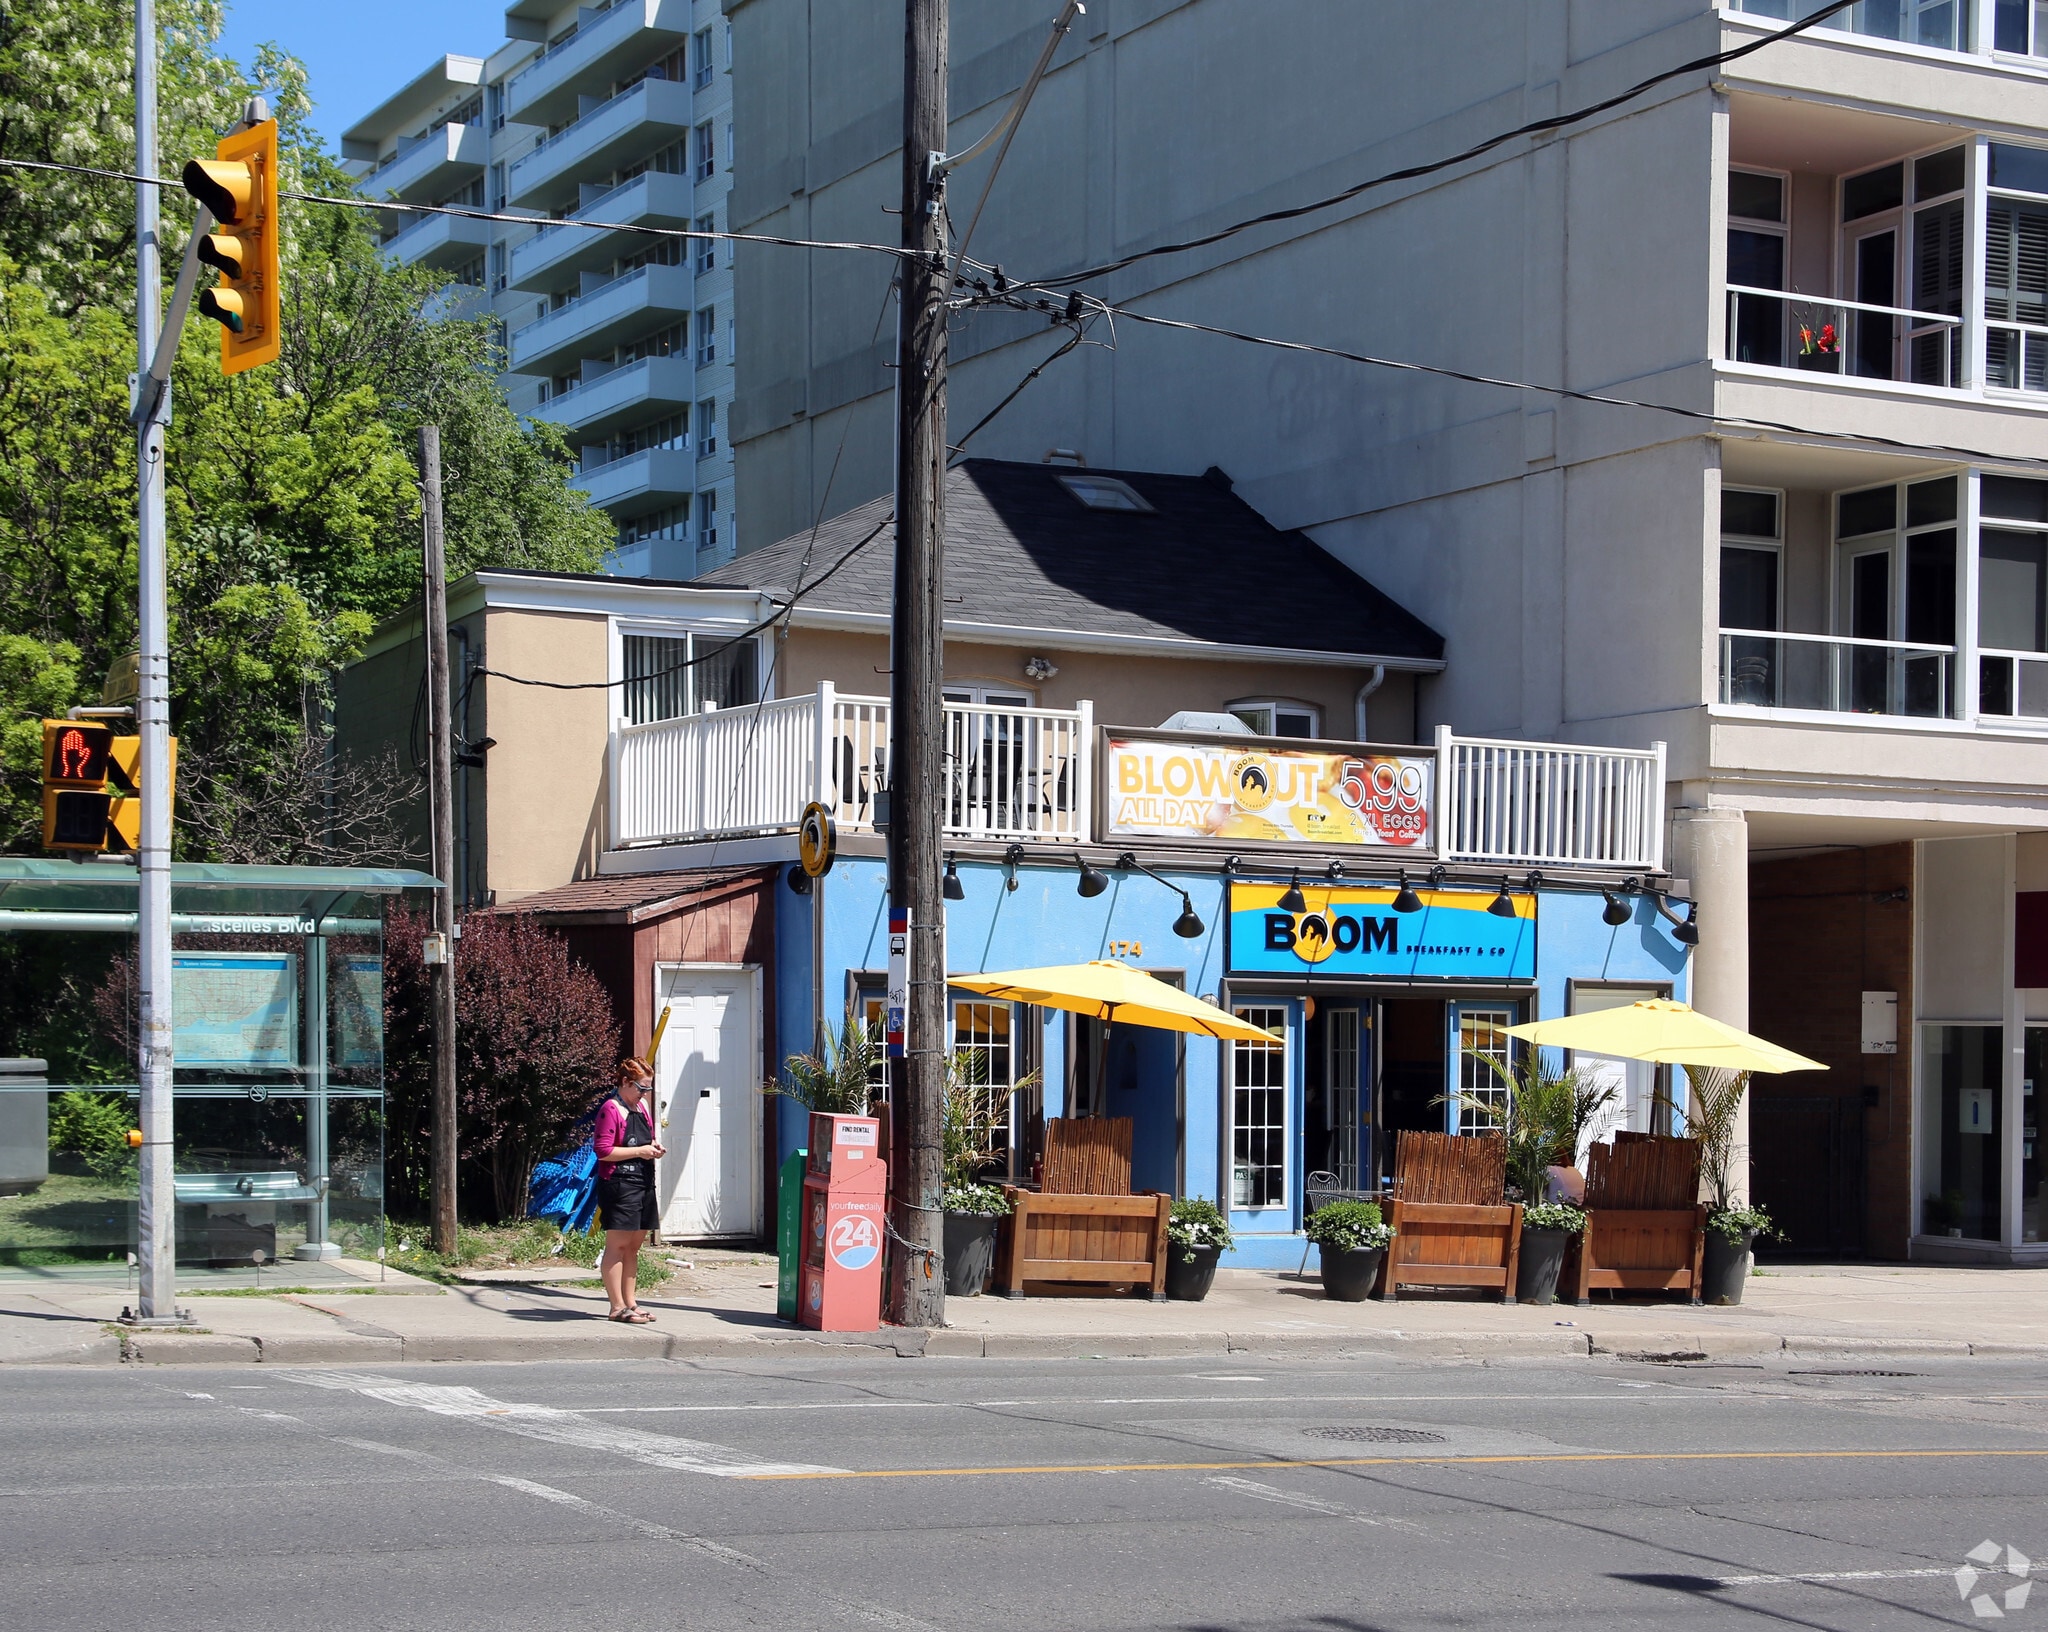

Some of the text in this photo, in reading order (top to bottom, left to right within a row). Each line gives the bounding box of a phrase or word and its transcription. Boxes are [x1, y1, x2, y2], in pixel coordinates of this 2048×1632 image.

[1340, 761, 1422, 814] 5.99
[1118, 799, 1212, 826] ALL DAY
[1349, 812, 1421, 830] 2 XL EGGS
[1377, 829, 1395, 838] Toast
[190, 917, 316, 934] Lascelles Blvd
[1109, 940, 1143, 958] 174
[1406, 945, 1472, 956] BREAKFAST
[1489, 947, 1506, 957] CO
[835, 1219, 873, 1247] 24
